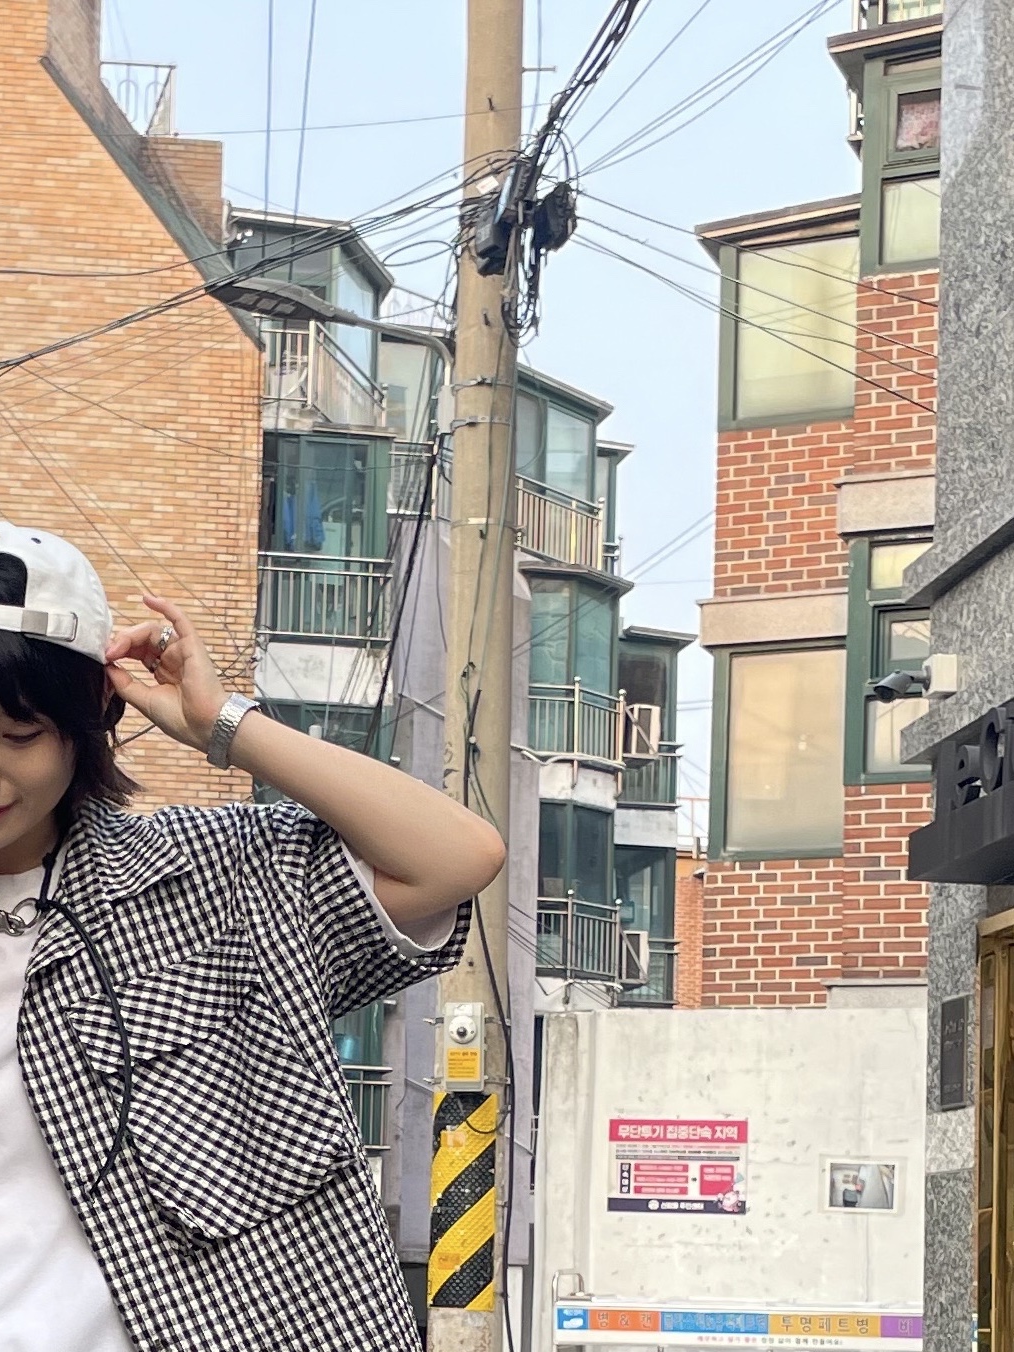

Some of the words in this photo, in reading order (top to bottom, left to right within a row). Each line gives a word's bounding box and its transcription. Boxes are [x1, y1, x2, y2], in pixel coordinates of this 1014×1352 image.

[618, 1125, 664, 1139] 무단투기
[667, 1125, 712, 1139] 집중단속
[714, 1126, 738, 1140] 지역
[598, 1312, 608, 1328] 병
[619, 1314, 629, 1328] &
[781, 1315, 869, 1334] 투명페트병
